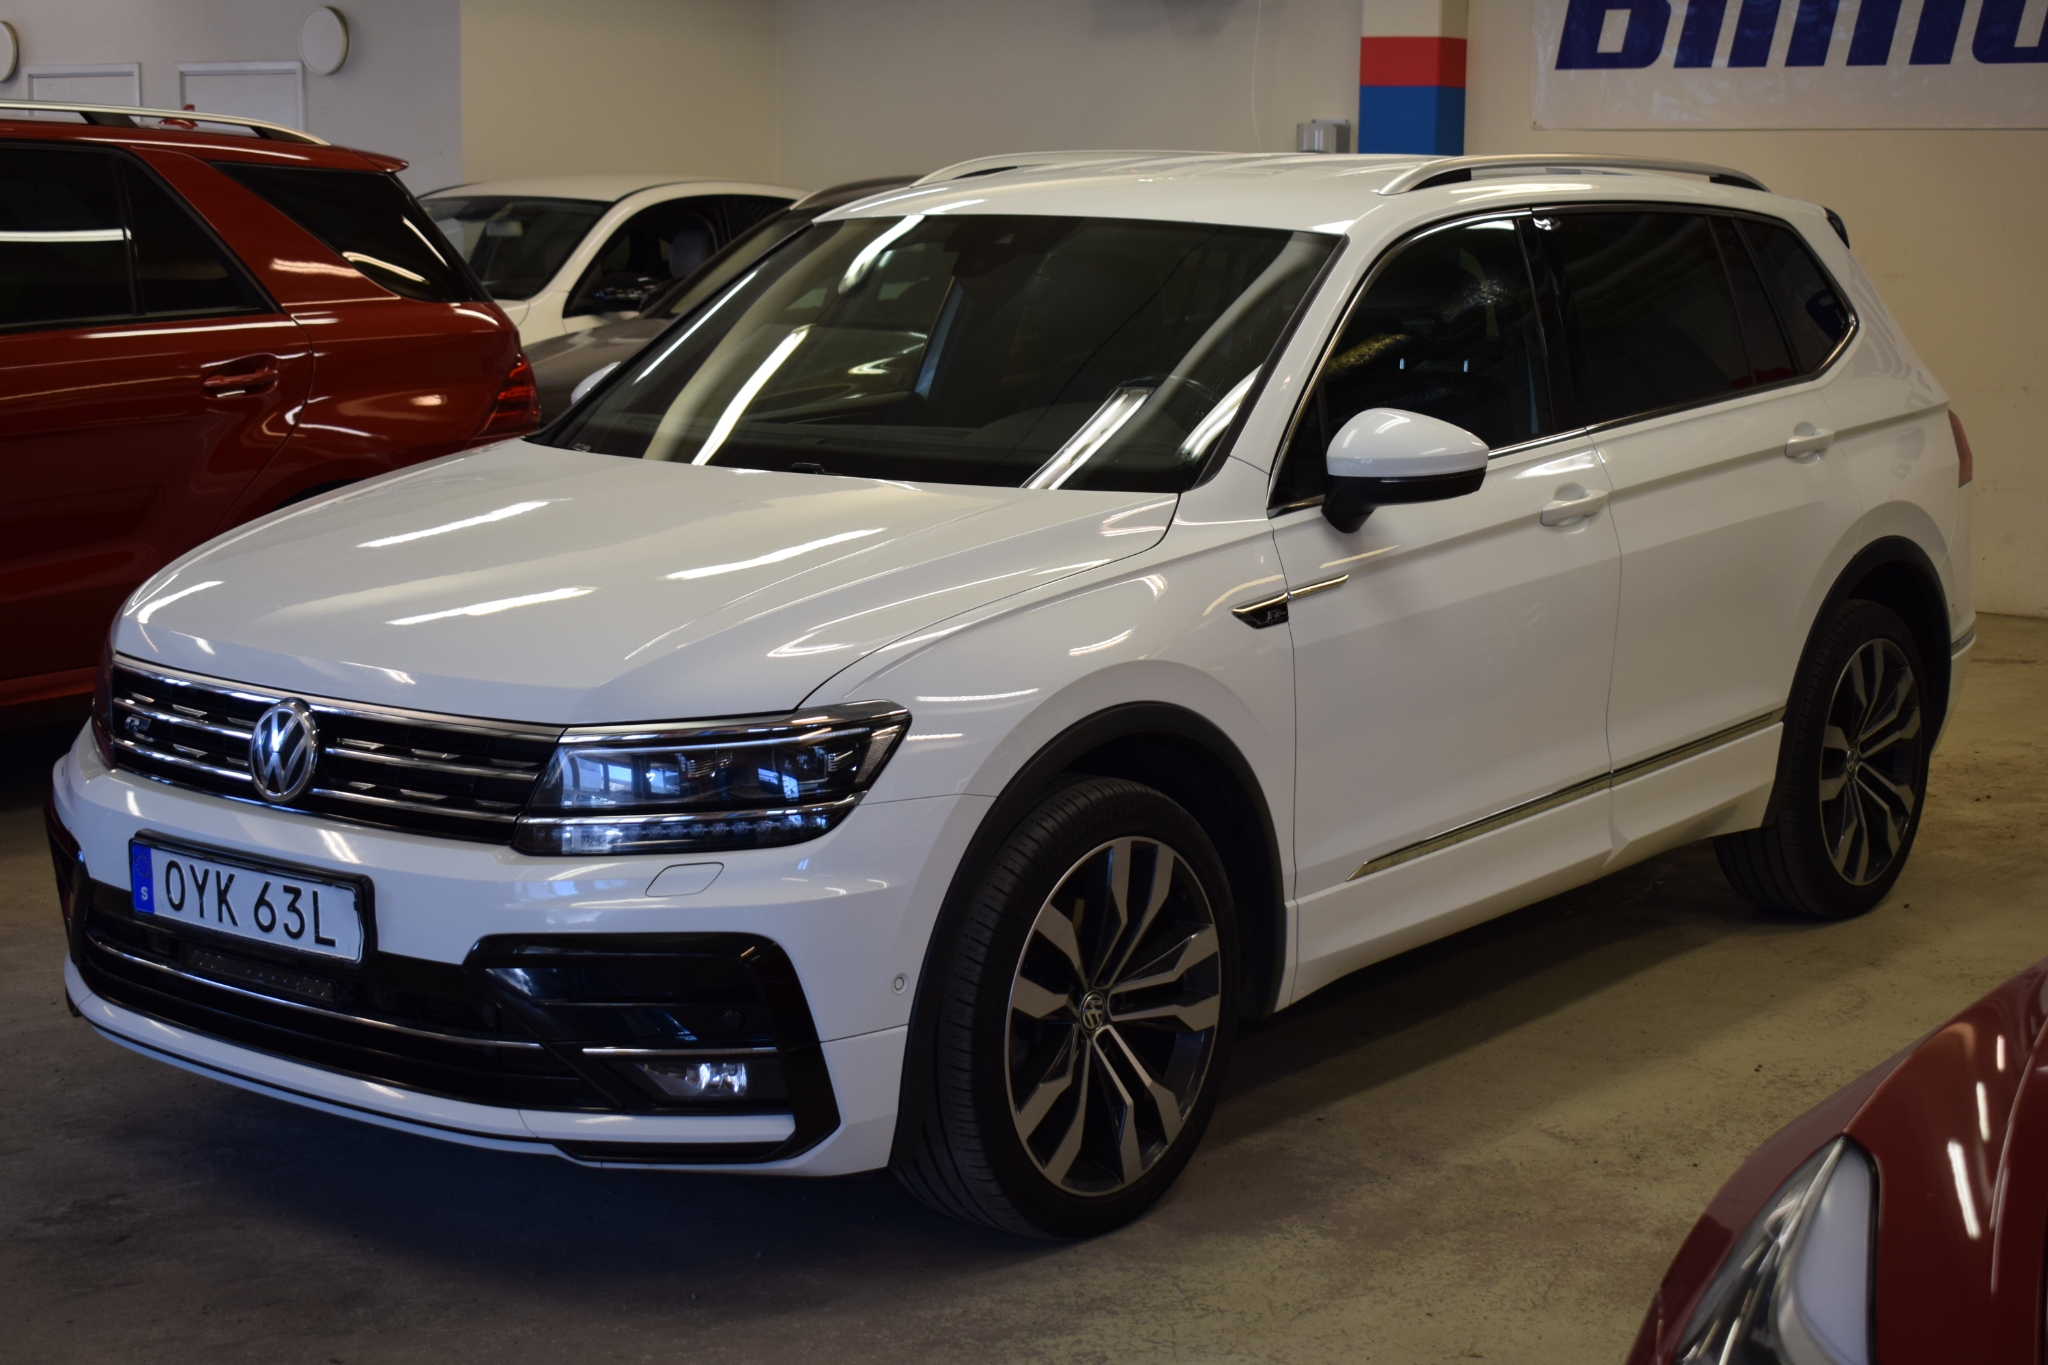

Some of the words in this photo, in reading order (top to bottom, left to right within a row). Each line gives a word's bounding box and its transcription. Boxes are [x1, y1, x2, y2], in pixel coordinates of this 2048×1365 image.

[141, 886, 149, 901] S
[165, 860, 239, 927] OYK
[254, 881, 336, 947] 63L
